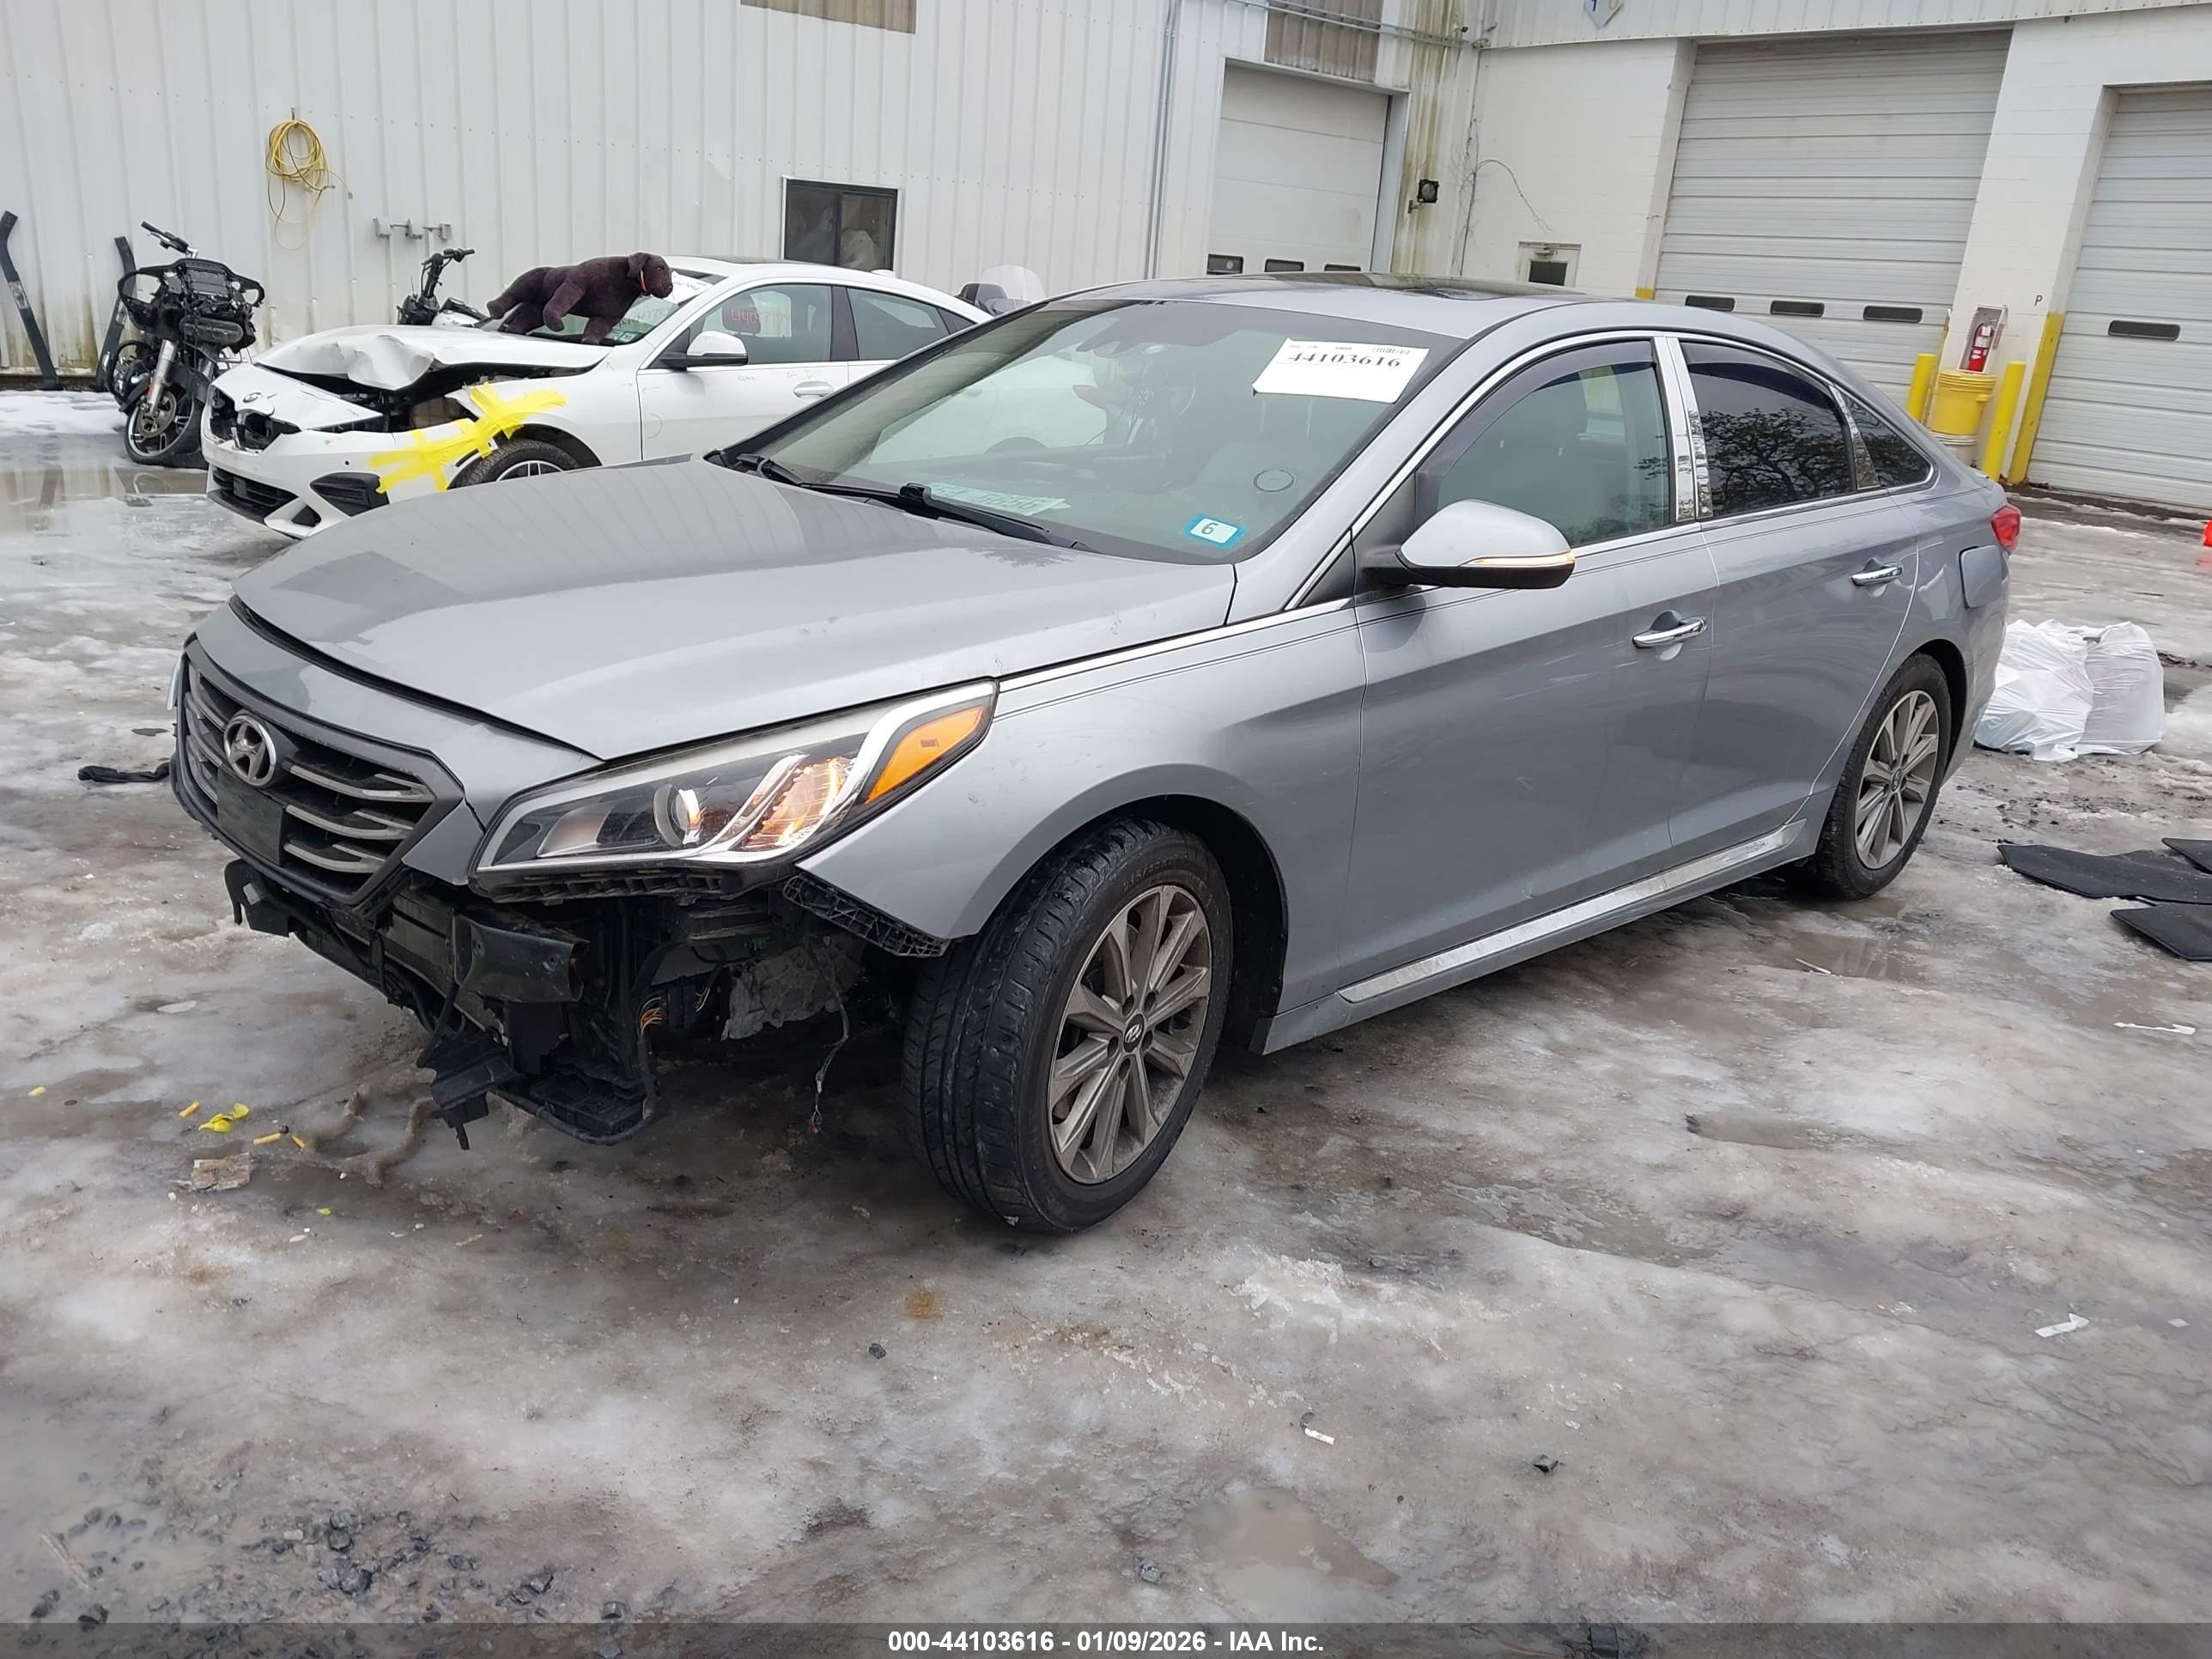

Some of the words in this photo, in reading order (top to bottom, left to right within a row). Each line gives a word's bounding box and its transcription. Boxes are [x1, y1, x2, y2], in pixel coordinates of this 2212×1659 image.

[2034, 295, 2043, 307] P
[1287, 351, 1402, 368] 44103616
[1200, 522, 1219, 535] 6
